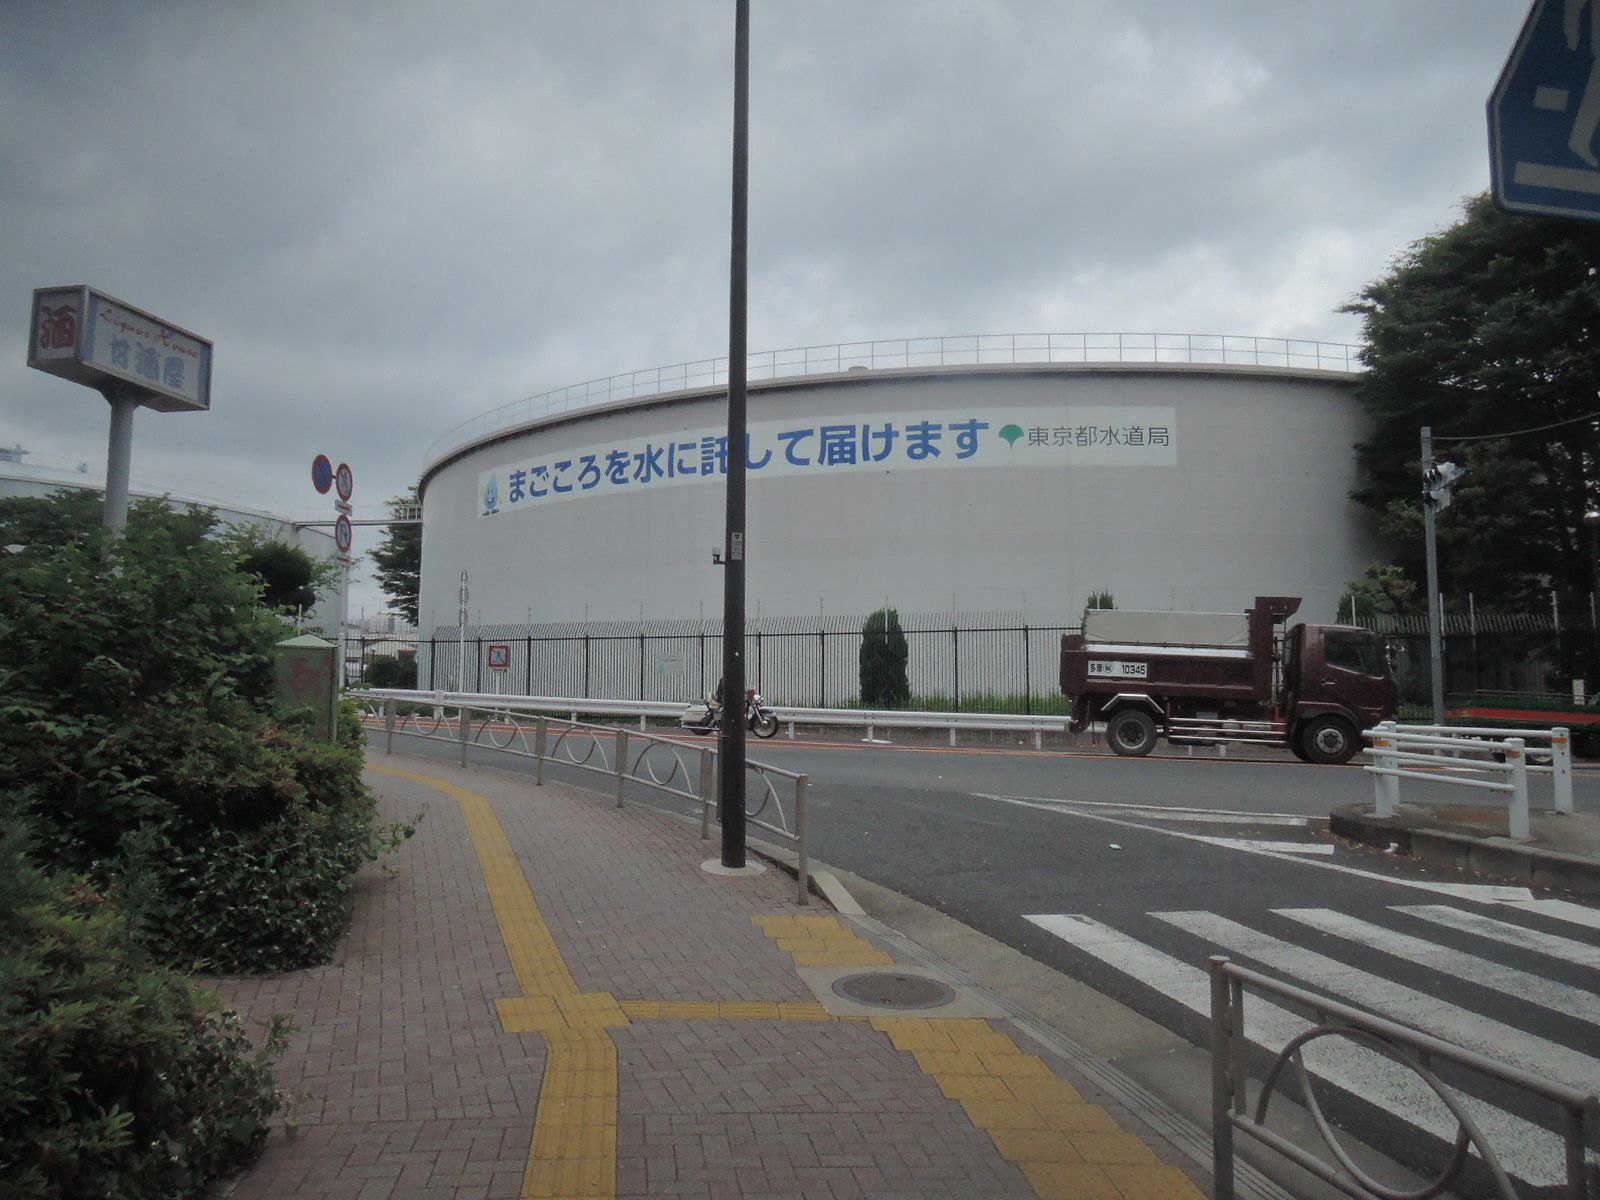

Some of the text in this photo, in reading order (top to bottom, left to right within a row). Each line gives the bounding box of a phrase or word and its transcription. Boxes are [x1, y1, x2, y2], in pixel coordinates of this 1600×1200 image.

[40, 304, 78, 349] 酒
[153, 328, 199, 359] House
[1028, 425, 1170, 447] 東京都水道局
